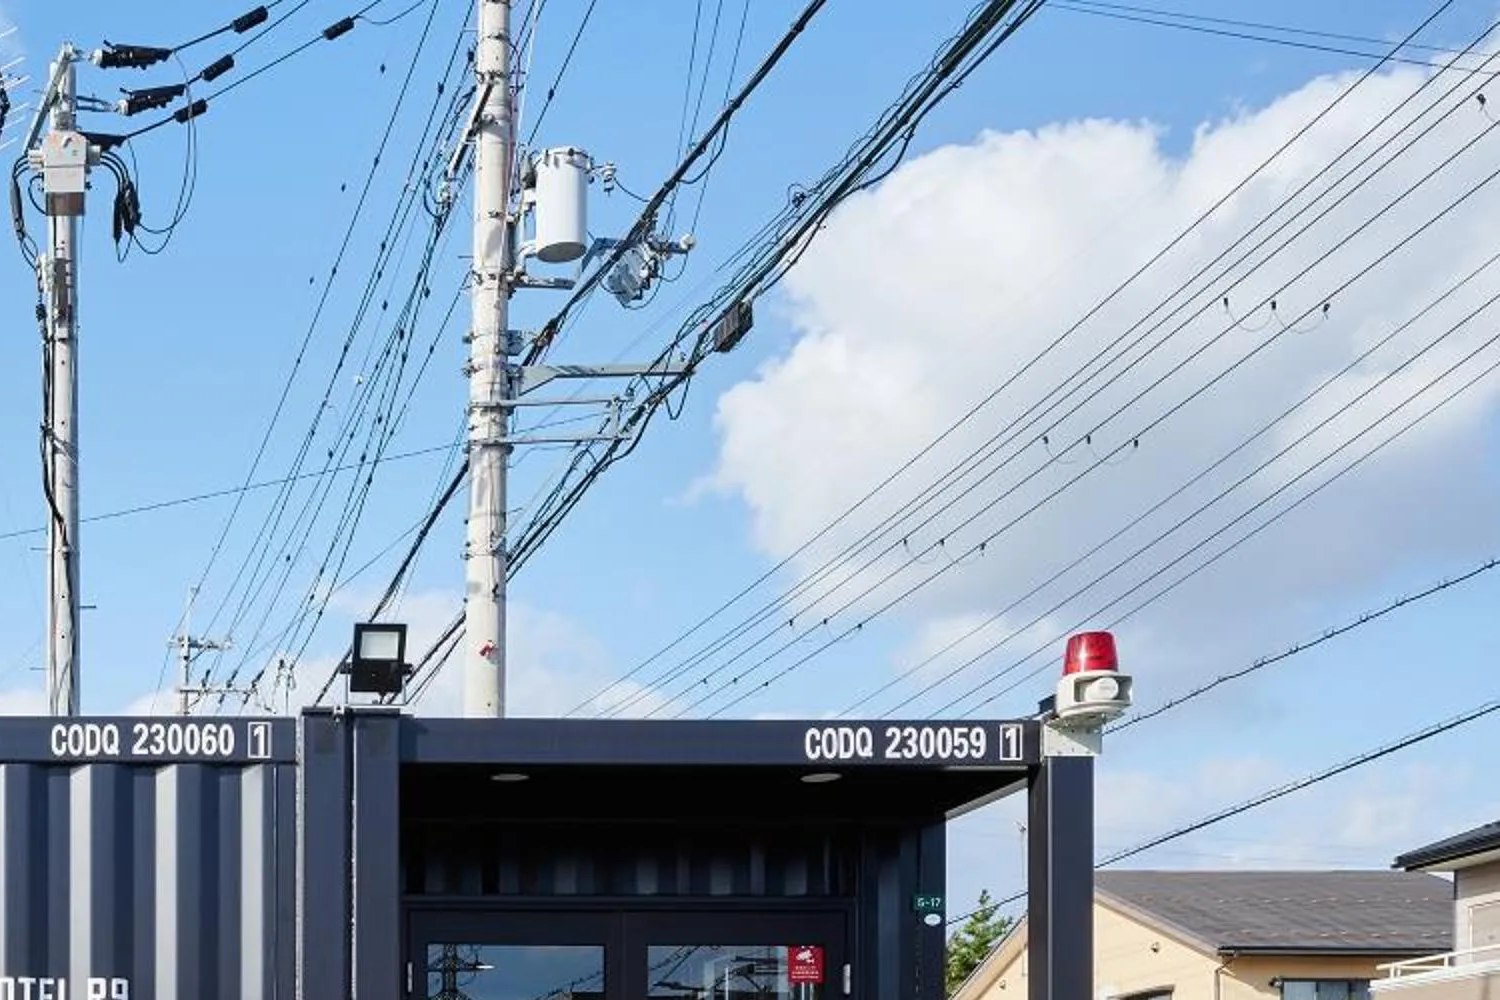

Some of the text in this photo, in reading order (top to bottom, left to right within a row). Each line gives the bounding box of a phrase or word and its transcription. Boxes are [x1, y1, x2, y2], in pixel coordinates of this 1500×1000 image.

[51, 723, 268, 756] CODQ 230060 1
[804, 726, 1020, 759] CODQ 230059 1
